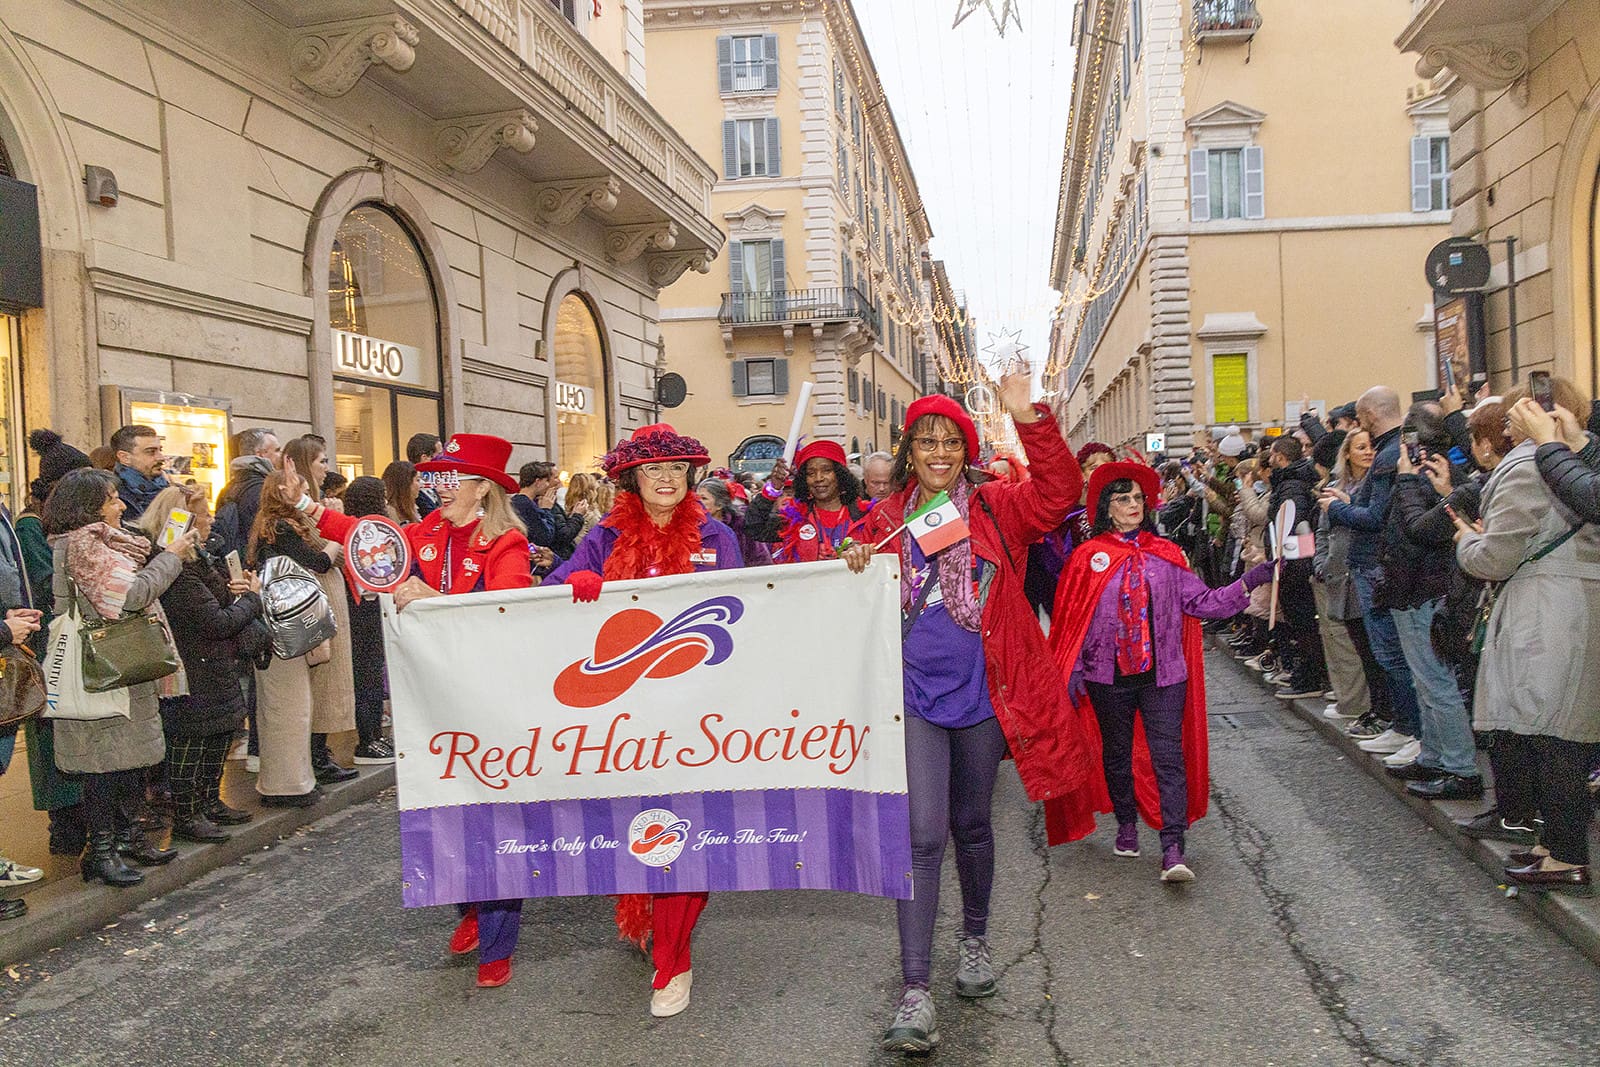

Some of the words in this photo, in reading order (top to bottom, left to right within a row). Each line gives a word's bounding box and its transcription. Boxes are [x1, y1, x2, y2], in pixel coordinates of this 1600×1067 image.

[48, 633, 69, 687] REFINITIV
[429, 726, 543, 790] Red
[552, 712, 674, 776] Hat
[676, 708, 871, 775] Society
[495, 839, 550, 855] There's
[552, 836, 587, 857] Only
[589, 834, 621, 850] One
[692, 829, 731, 851] Join
[732, 828, 766, 845] The
[766, 828, 808, 844] Fun!
